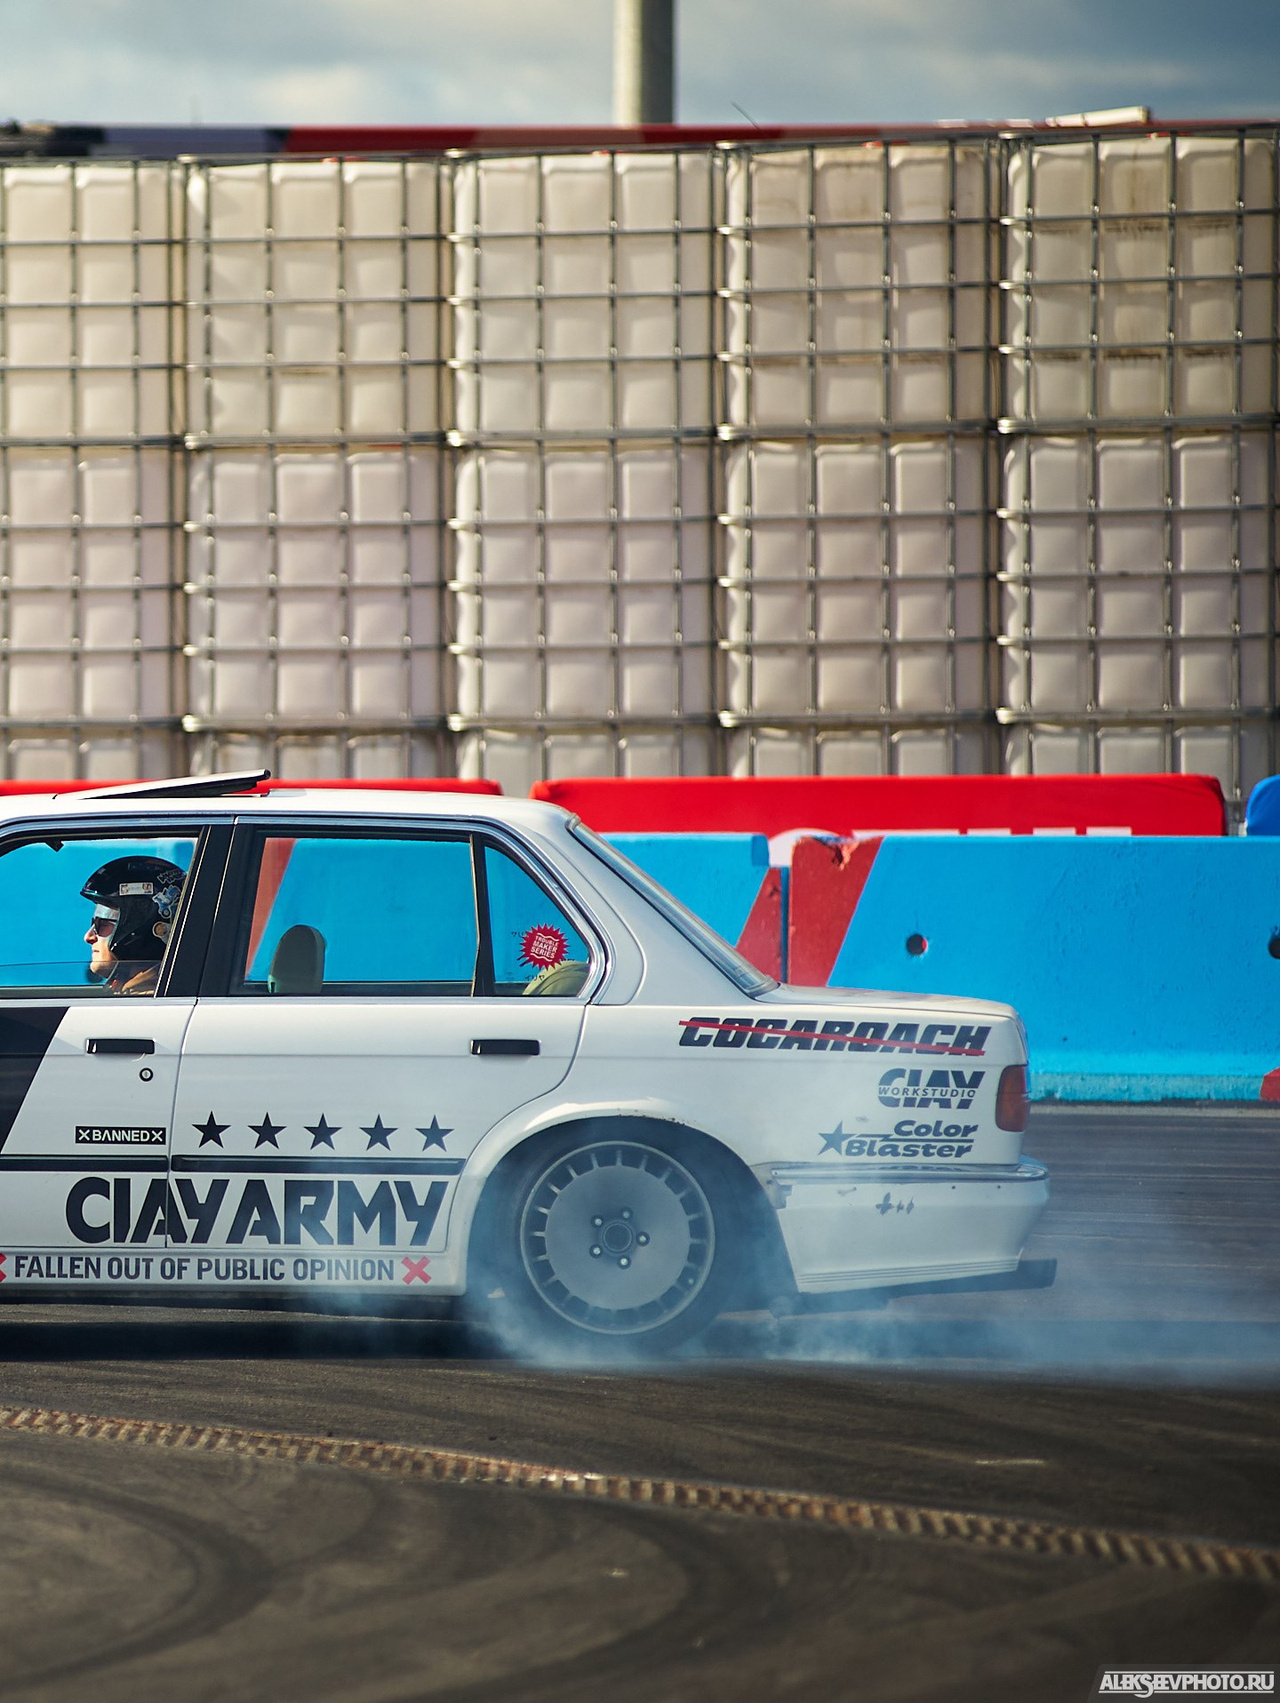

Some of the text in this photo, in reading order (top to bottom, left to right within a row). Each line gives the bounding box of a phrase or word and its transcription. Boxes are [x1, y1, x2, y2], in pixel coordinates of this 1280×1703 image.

[533, 940, 558, 953] MAKER
[535, 935, 559, 947] TROUBLE
[530, 946, 556, 959] SERIES
[679, 1016, 992, 1057] COCAROACH
[877, 1086, 976, 1098] WORKSTUDIO
[893, 1119, 979, 1138] Color
[845, 1138, 975, 1158] Blaster
[14, 1255, 394, 1281] FALLEN OUT OF PUBLIC OPINION
